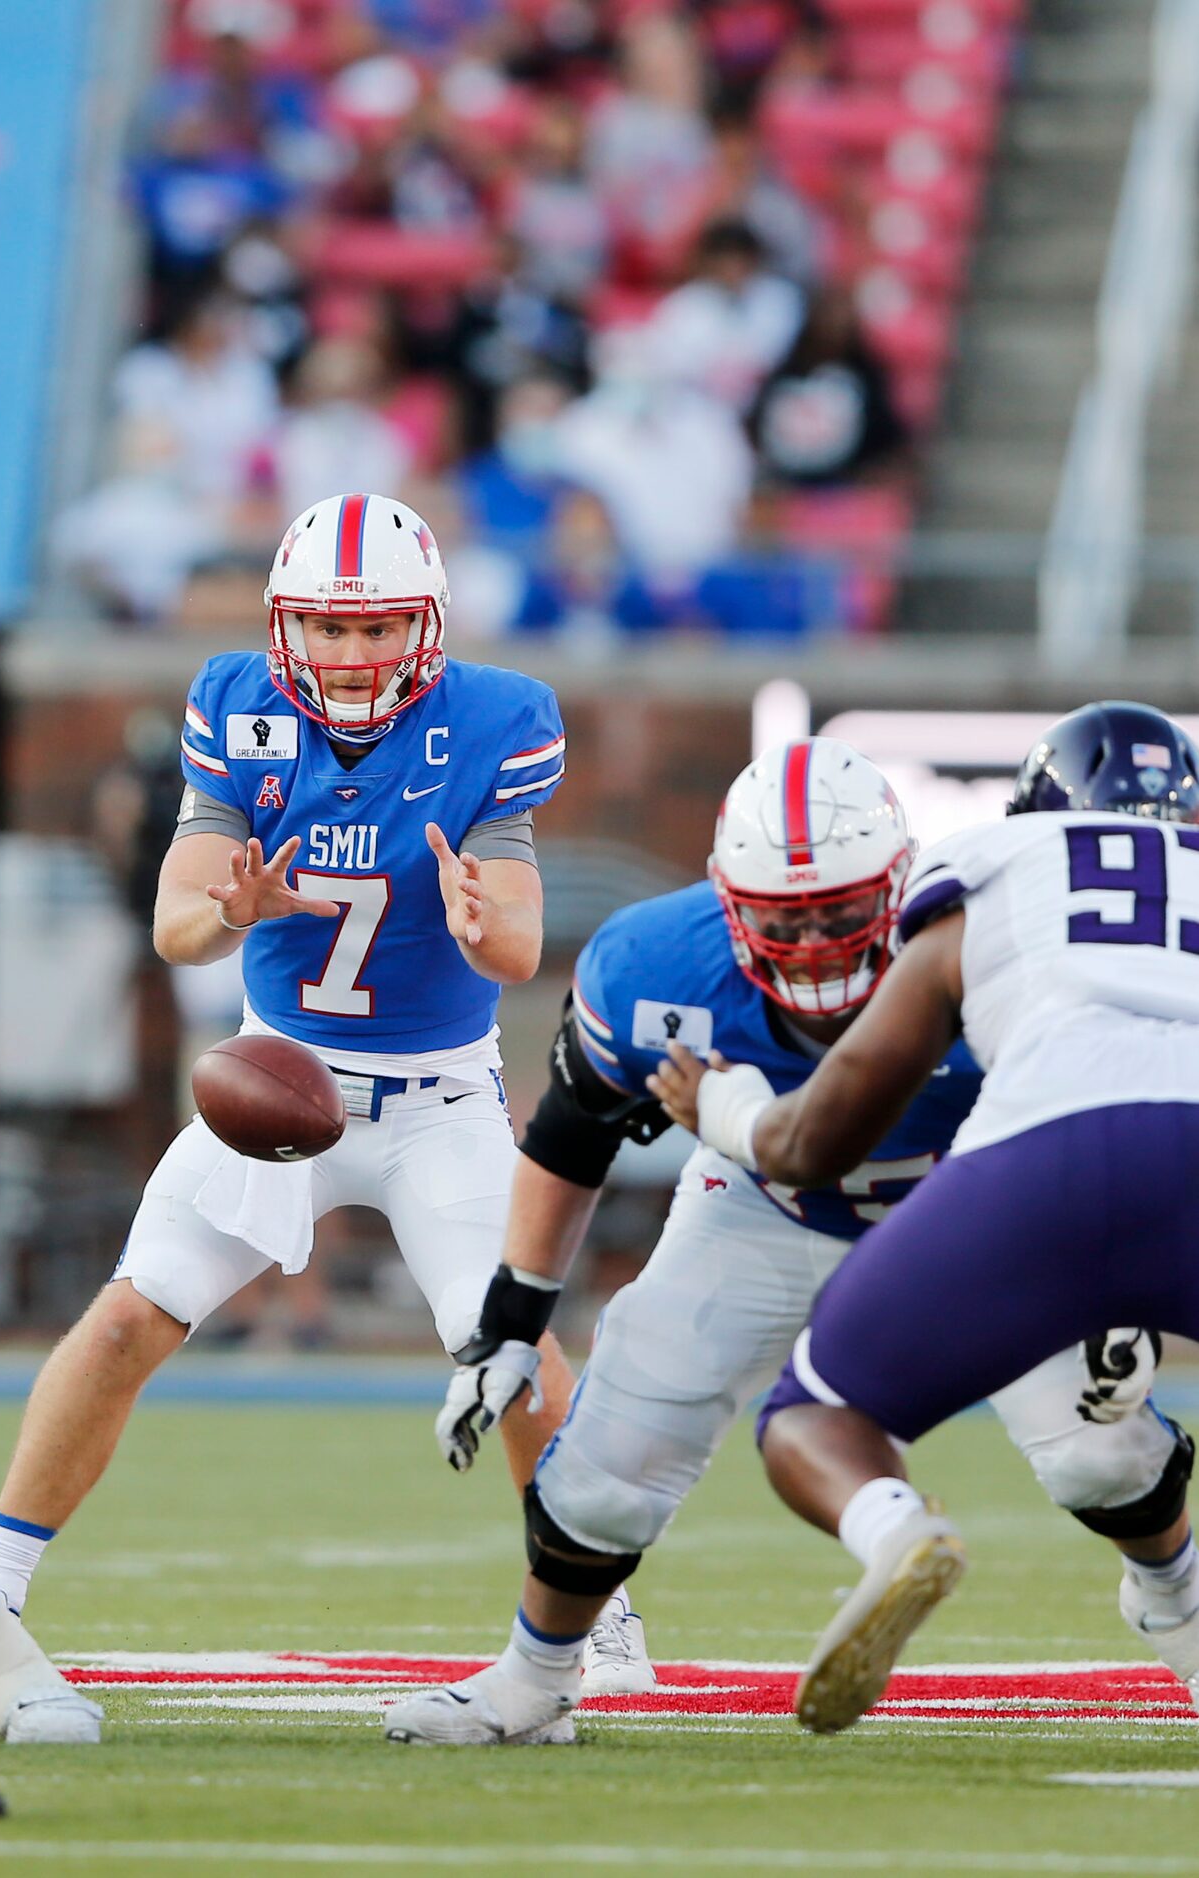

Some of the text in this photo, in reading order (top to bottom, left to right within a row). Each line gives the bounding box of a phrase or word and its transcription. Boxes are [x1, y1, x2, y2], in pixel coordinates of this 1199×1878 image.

[332, 580, 365, 593] SMU
[235, 748, 288, 758] GREAT FAMILY
[426, 726, 449, 766] C
[308, 823, 379, 870] SMU
[294, 868, 393, 1018] 7
